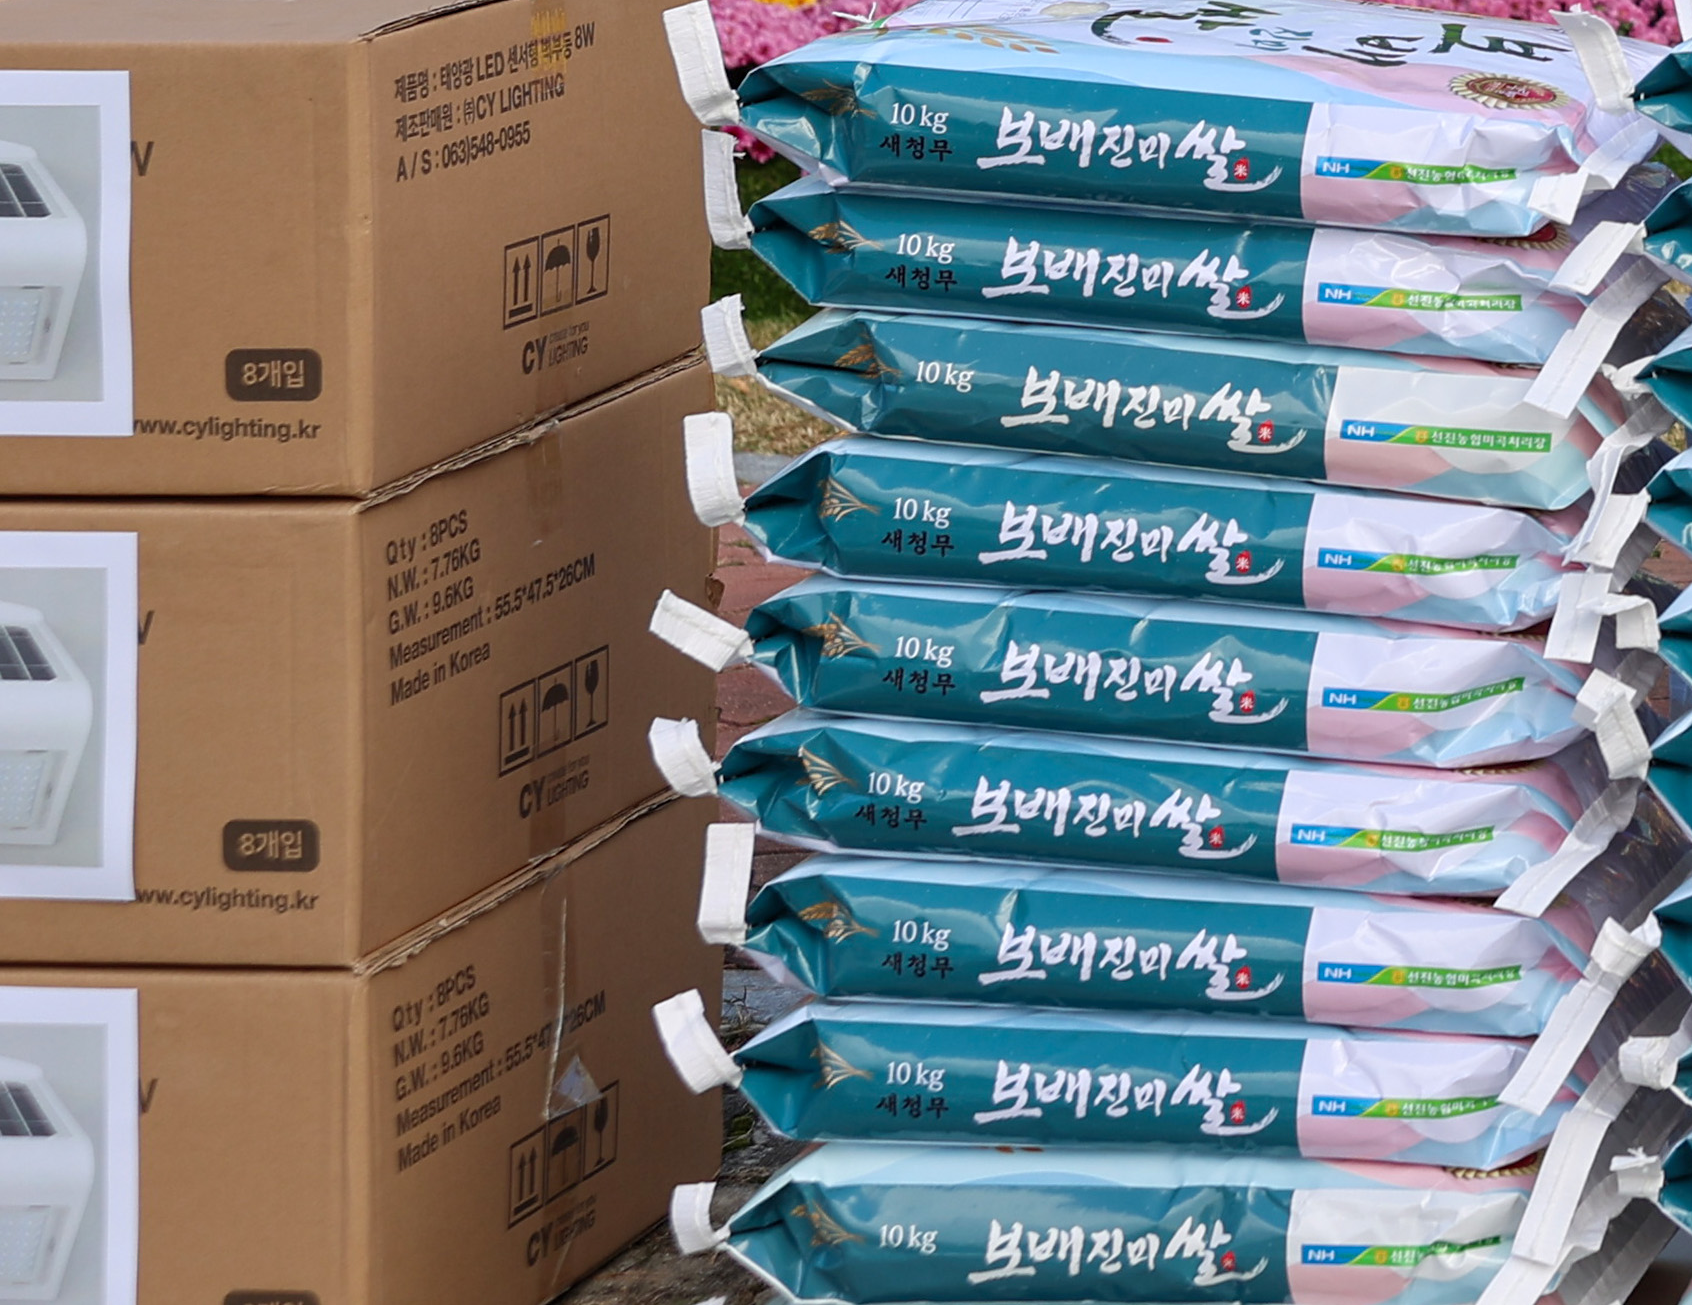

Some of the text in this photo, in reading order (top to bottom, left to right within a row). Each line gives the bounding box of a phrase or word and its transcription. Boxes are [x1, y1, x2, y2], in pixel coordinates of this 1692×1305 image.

[394, 69, 429, 103] 제품명
[440, 57, 474, 89] 태양광
[476, 51, 504, 81] LED
[575, 22, 595, 49] 8W
[395, 102, 452, 142] 제조판매원
[500, 73, 565, 114] LIGHTING
[442, 121, 531, 168] 063)548-0955
[879, 131, 953, 162] 새청무
[977, 107, 1282, 191] 보배진미쌀
[1322, 159, 1353, 175] NH
[885, 263, 959, 292] 새청무
[982, 237, 1284, 319] 보배진미쌀
[242, 360, 304, 388] 8개입
[522, 335, 547, 374] CY
[133, 416, 321, 443] ww.cylighting.kr
[1001, 366, 1306, 453] 보배진미쌀
[1347, 424, 1375, 437] NH
[386, 509, 468, 566] Qty 8PCS
[388, 538, 481, 601] N.W. 7.76KG
[978, 501, 1283, 585] 보배진미쌀
[389, 576, 474, 635] G.W. 9.6KG
[389, 606, 484, 670] Measurement
[390, 642, 490, 706] Made in Korea
[981, 641, 1287, 723] 보배진미쌀
[238, 830, 303, 858] 8개입
[952, 778, 1255, 858] 보배진미쌀
[978, 923, 1282, 1001] 보배진미쌀
[439, 992, 490, 1040] 7.76KG
[441, 1031, 484, 1075] 9.6KG
[396, 1061, 495, 1136] Measurement
[974, 1061, 1278, 1135] 보배진미쌀
[397, 1132, 438, 1172] Made
[460, 1095, 500, 1135] Korea
[968, 1218, 1268, 1285] 보배진미쌀
